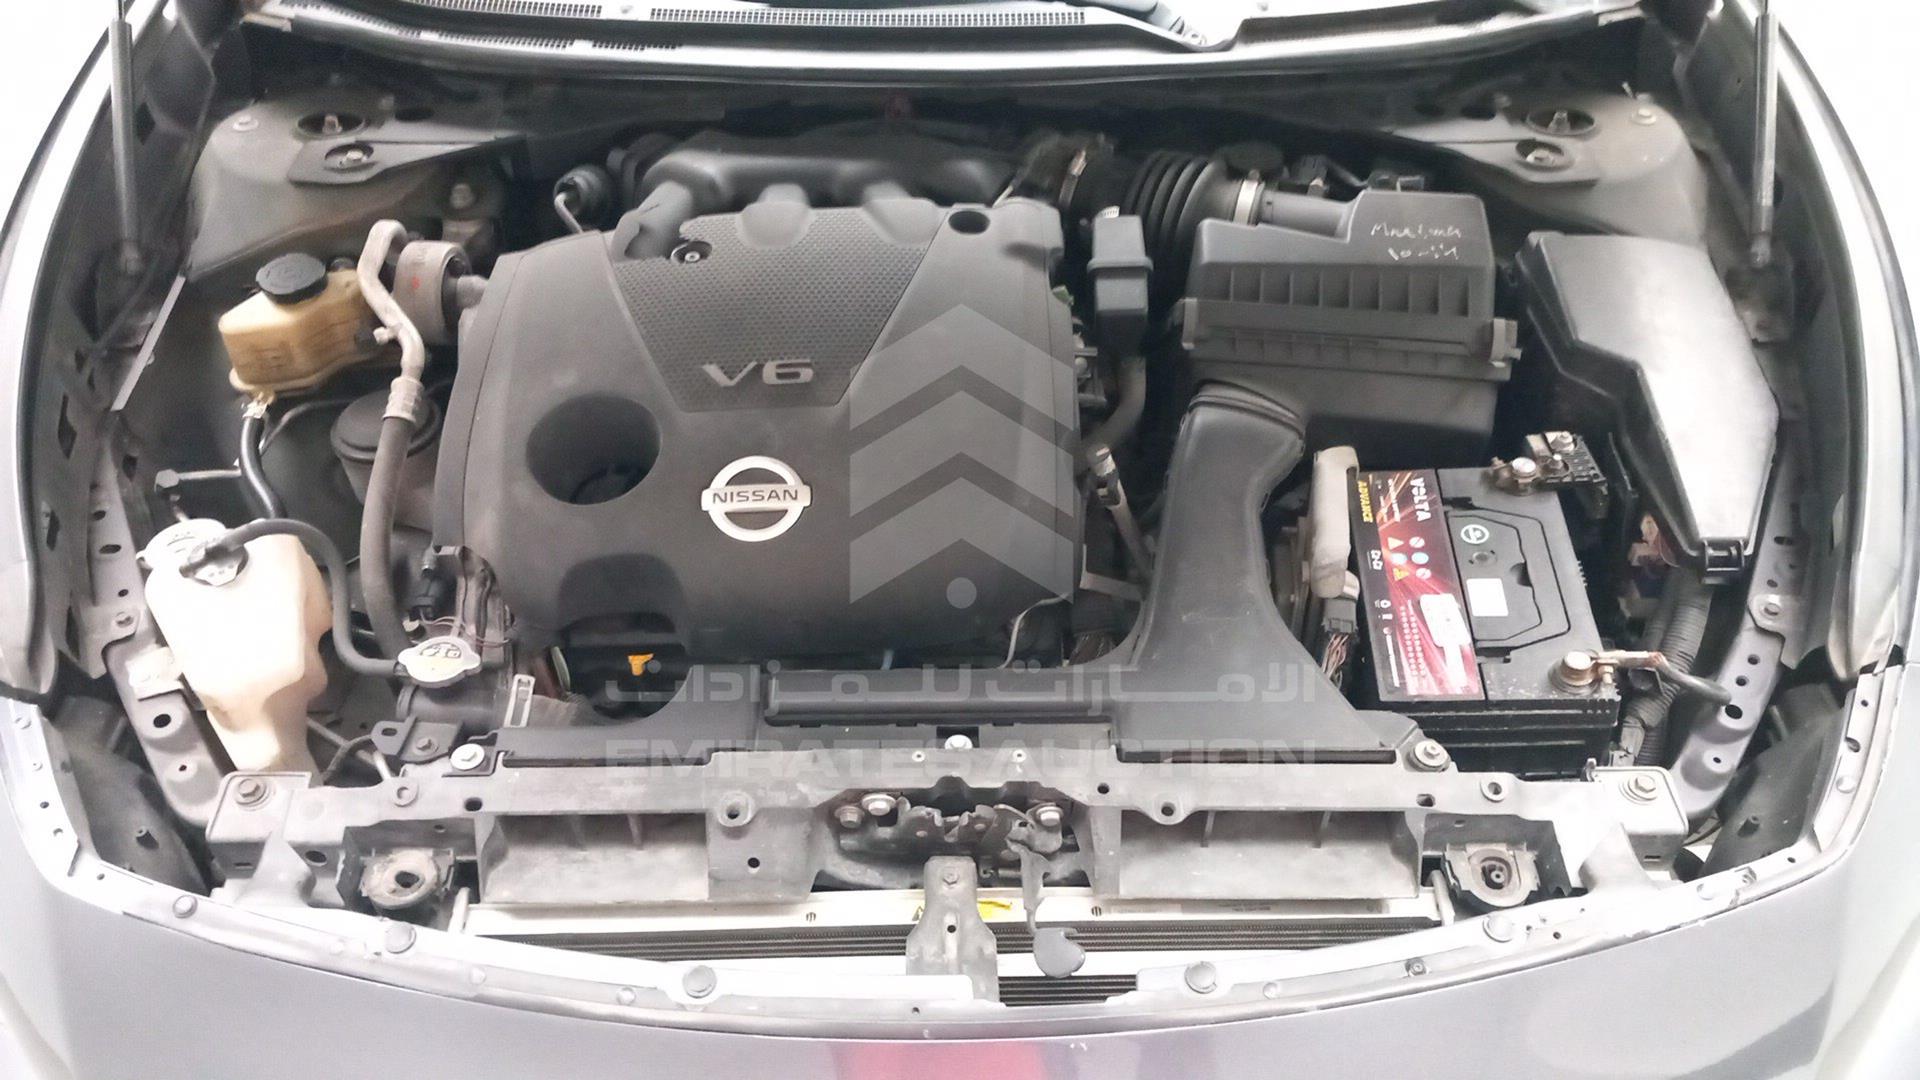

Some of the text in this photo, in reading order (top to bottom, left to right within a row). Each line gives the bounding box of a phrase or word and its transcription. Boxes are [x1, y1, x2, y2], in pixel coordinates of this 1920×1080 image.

[702, 359, 814, 387] V6
[712, 489, 799, 504] NISSAN
[1357, 480, 1374, 523] ADVANCE
[1410, 477, 1431, 521] VOLTA
